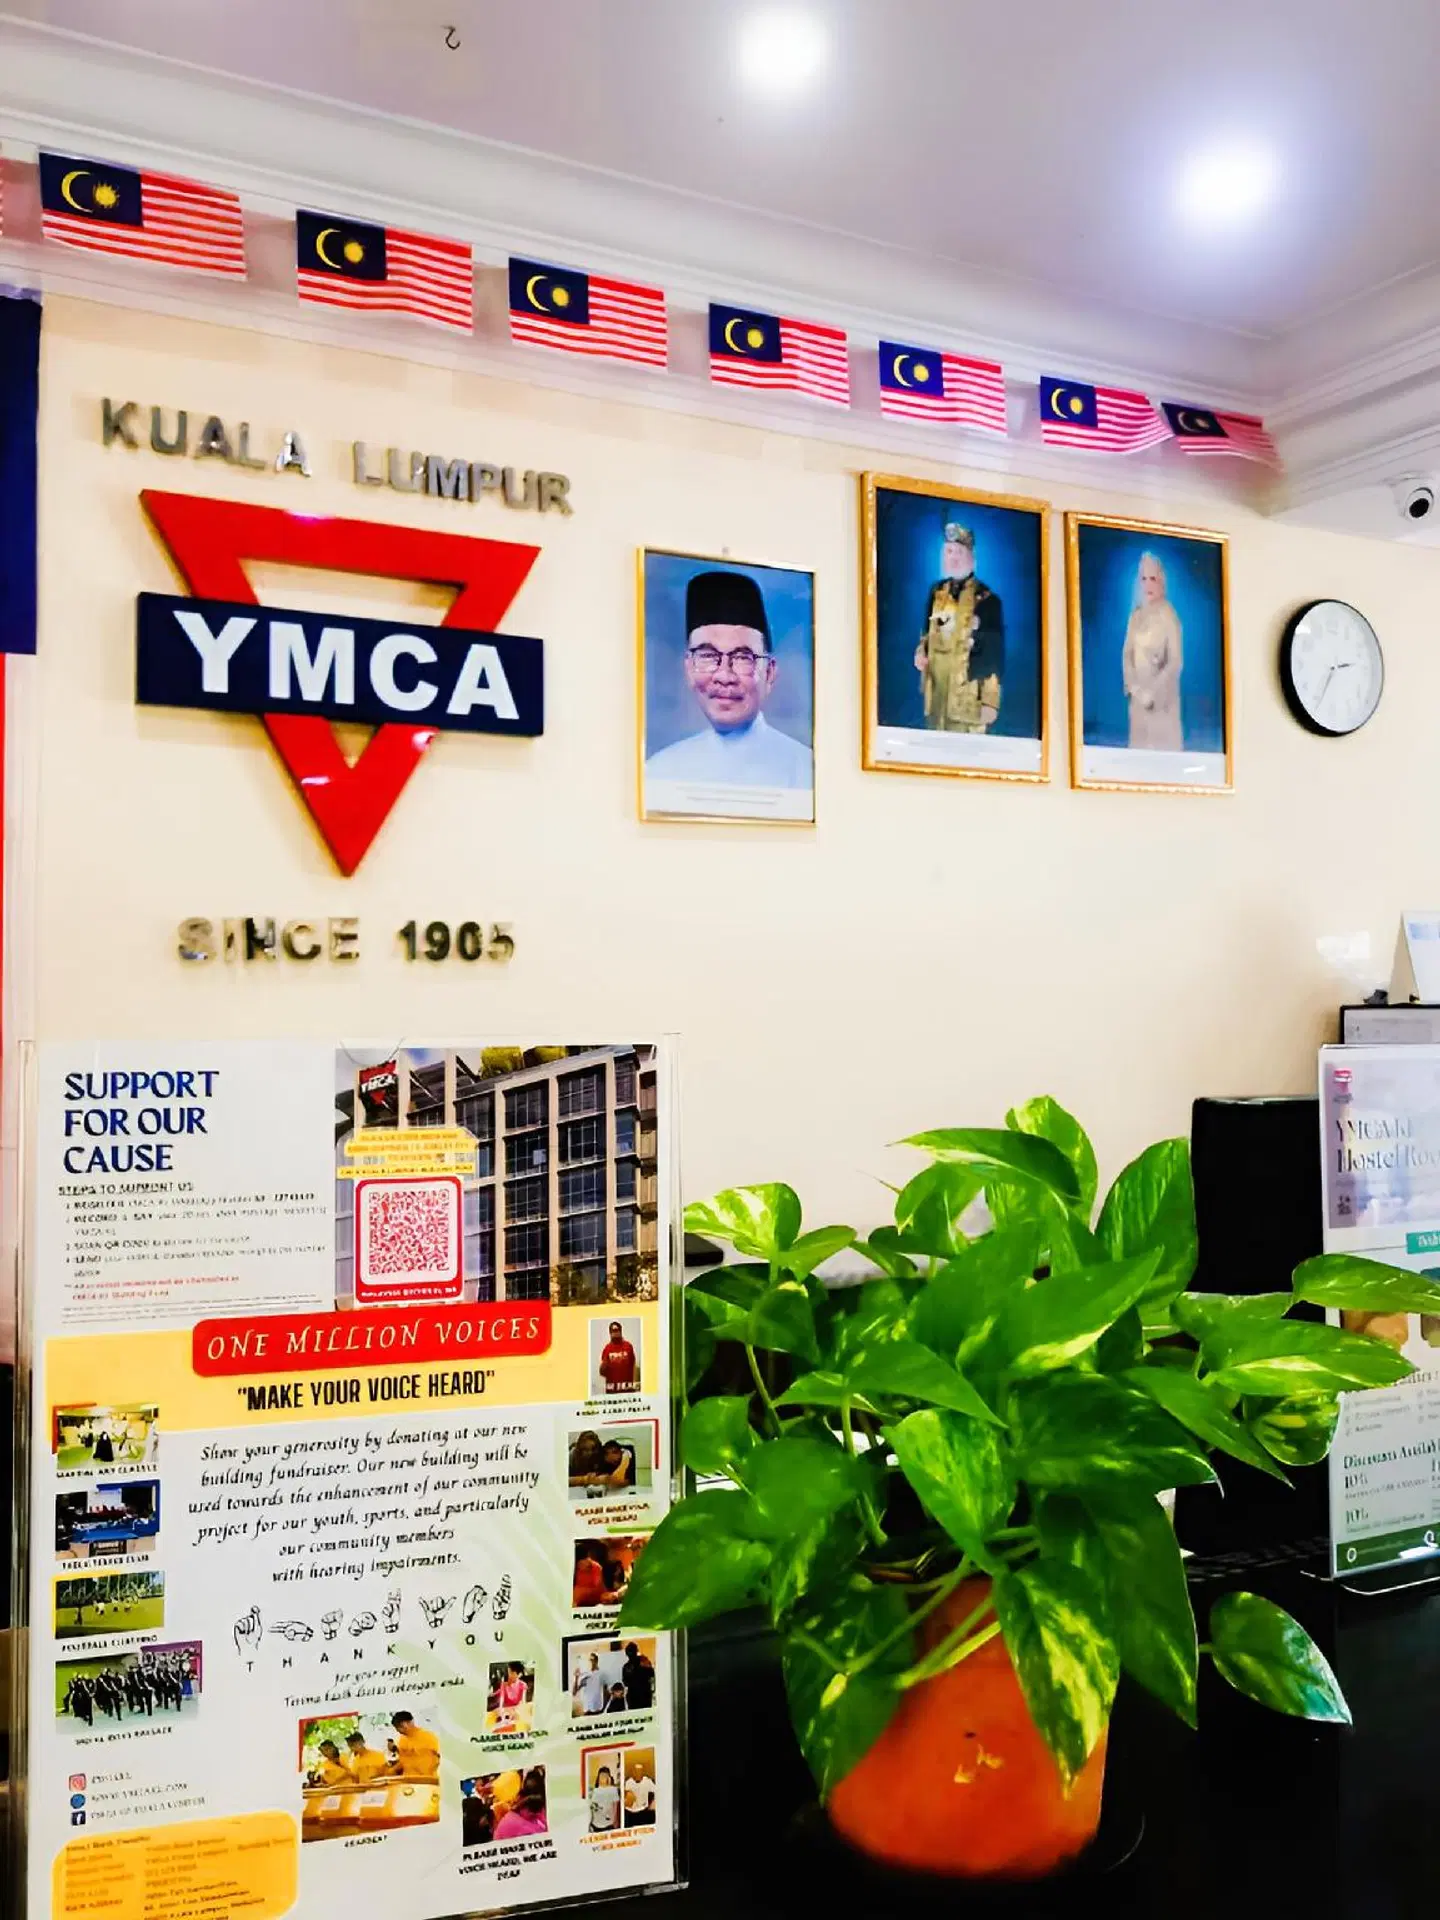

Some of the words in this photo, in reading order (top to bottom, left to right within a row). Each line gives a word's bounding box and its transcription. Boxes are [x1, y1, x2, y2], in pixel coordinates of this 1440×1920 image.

[102, 397, 312, 478] KUALA
[352, 440, 575, 518] LUMPUR
[172, 609, 520, 720] YMCA
[177, 916, 360, 963] SINCE
[398, 919, 516, 963] 1905
[64, 1071, 220, 1101] SUPPORT
[64, 1109, 130, 1137] FOR
[137, 1107, 208, 1135] OUR
[63, 1144, 174, 1174] CAUSE
[1335, 1146, 1400, 1173] Hostel
[99, 1183, 116, 1195] TO
[206, 1329, 271, 1361] ONE
[286, 1317, 421, 1355] MILLION
[434, 1317, 541, 1345] VOICES
[238, 1382, 304, 1412] "MAKE
[310, 1379, 361, 1407] YOUR
[368, 1373, 421, 1402] VOICE
[428, 1369, 496, 1398] HEARD"
[200, 1440, 239, 1461] Show
[244, 1444, 280, 1465] your
[280, 1436, 360, 1462] generosity
[364, 1430, 384, 1450] by
[386, 1428, 450, 1449] donating
[453, 1426, 470, 1441] at
[473, 1427, 499, 1440] our
[502, 1423, 528, 1436] new
[200, 1462, 263, 1488] building
[269, 1458, 352, 1486] fundraiser.
[357, 1458, 386, 1473] Our
[390, 1457, 418, 1470] new
[421, 1446, 479, 1469] building
[485, 1445, 510, 1461] will
[513, 1442, 529, 1459] be
[188, 1496, 221, 1515] used
[227, 1494, 285, 1512] towards
[289, 1486, 312, 1505] the
[316, 1482, 410, 1502] enhancement
[413, 1475, 430, 1498] of
[433, 1478, 459, 1492] our
[462, 1470, 541, 1491] community
[191, 1523, 249, 1548] project
[250, 1515, 279, 1541] for
[281, 1517, 308, 1531] our
[413, 1500, 441, 1519] and
[442, 1492, 530, 1521] particularly
[278, 1542, 306, 1556] our
[309, 1532, 391, 1555] community
[395, 1526, 455, 1545] members
[271, 1564, 304, 1583] with
[309, 1561, 366, 1582] hearing
[370, 1551, 462, 1580] impairments.
